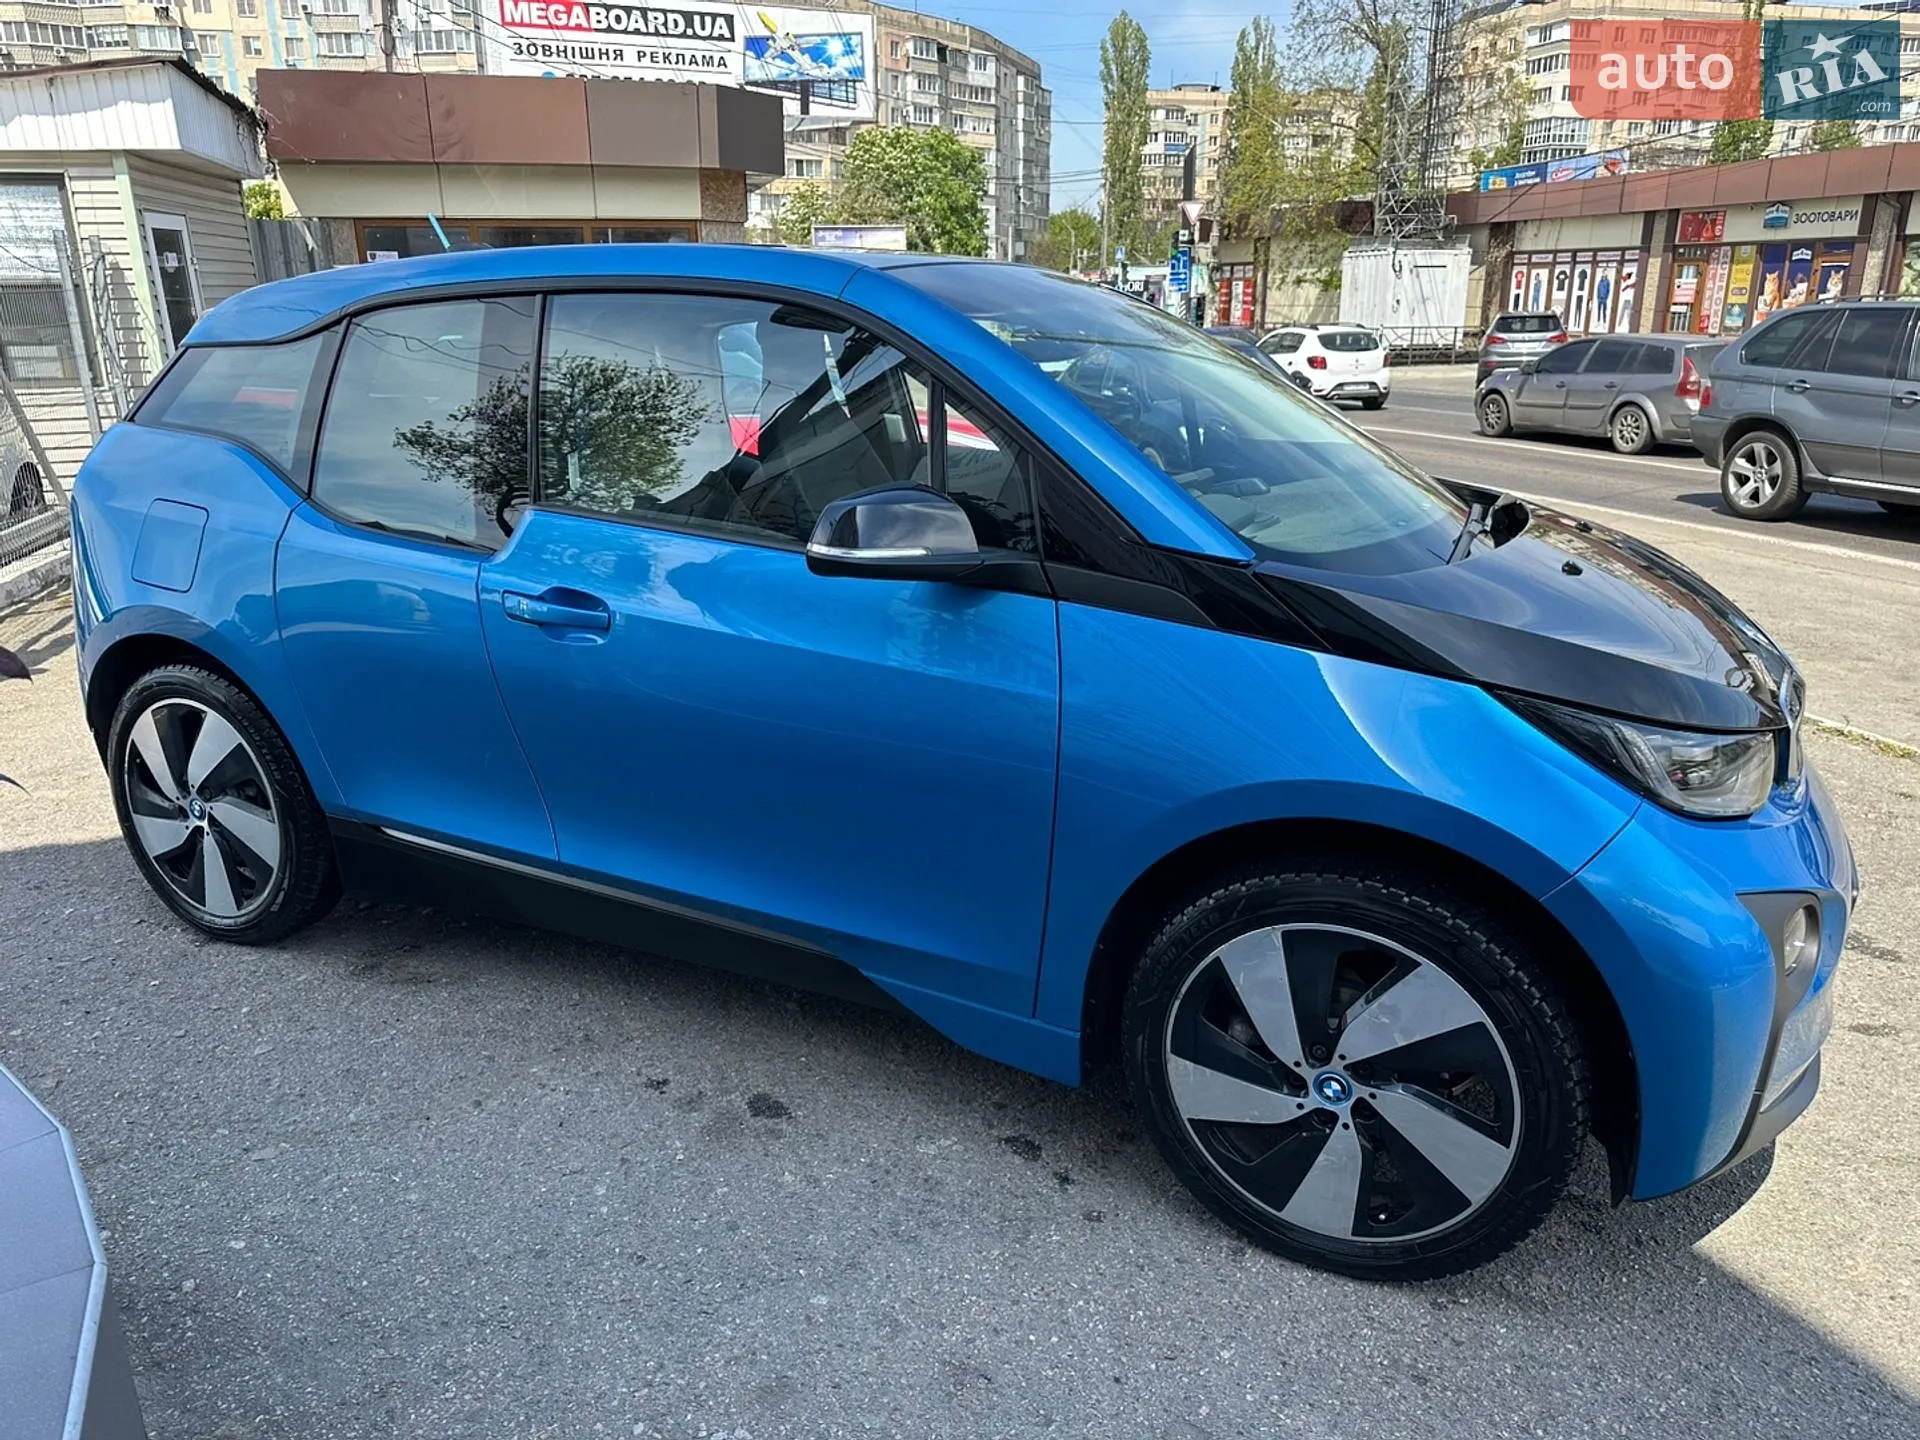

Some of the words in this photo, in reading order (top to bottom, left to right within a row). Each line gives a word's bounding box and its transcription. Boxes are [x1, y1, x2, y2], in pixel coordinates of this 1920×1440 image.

[502, 1, 732, 38] MEGABOARD.UA
[512, 42, 625, 62] ЗОВНІШНЯ
[637, 50, 729, 69] РЕКЛАМА
[1793, 208, 1859, 224] ЗООТОВАРИ
[1710, 247, 1730, 331] КСЕРОКС
